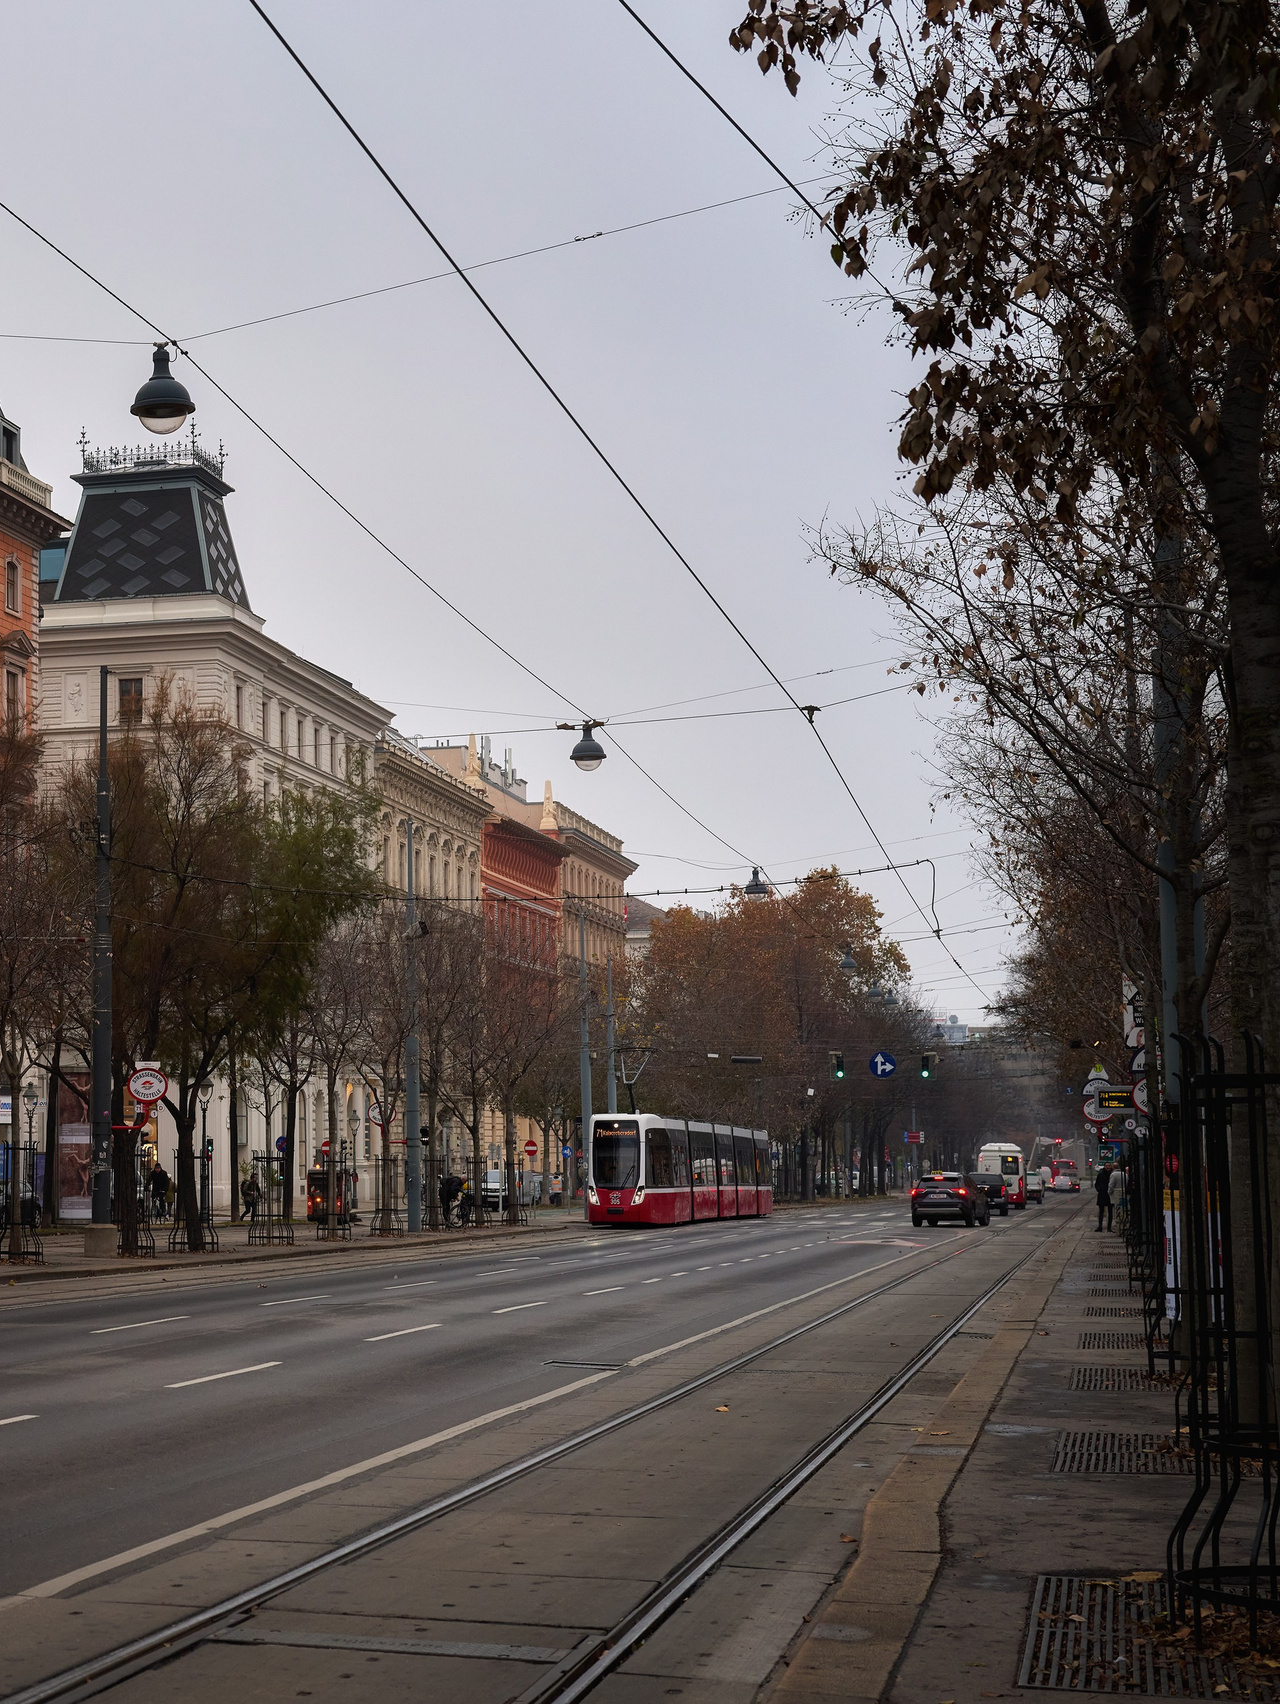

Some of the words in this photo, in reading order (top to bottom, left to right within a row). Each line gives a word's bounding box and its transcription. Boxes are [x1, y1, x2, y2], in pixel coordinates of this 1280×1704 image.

[132, 1072, 163, 1083] STRASSENBAHN
[133, 1088, 162, 1098] HALTESTELLE
[596, 1129, 603, 1137] 71
